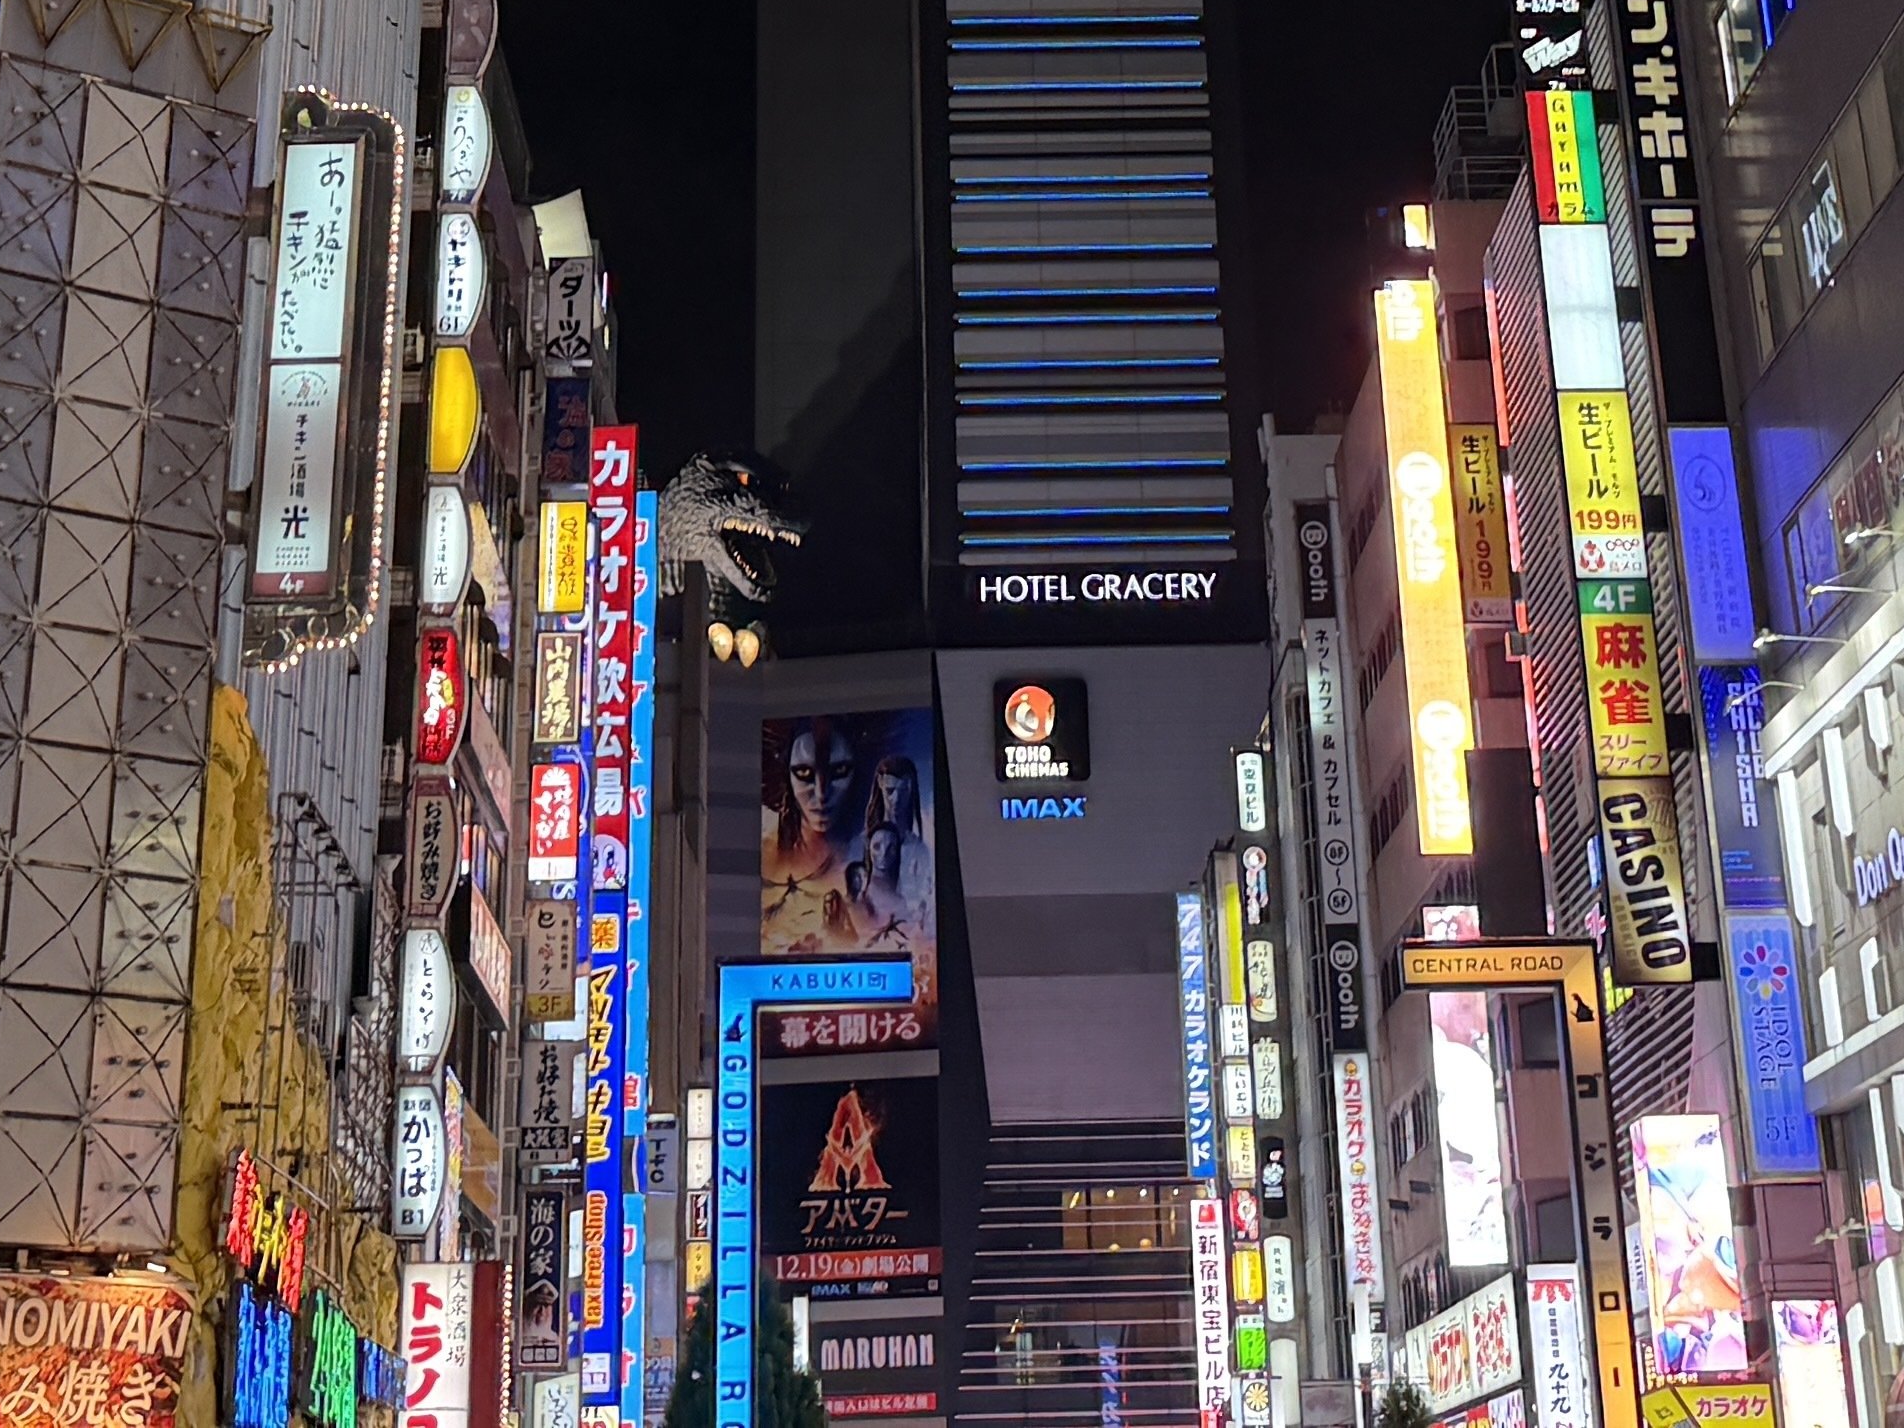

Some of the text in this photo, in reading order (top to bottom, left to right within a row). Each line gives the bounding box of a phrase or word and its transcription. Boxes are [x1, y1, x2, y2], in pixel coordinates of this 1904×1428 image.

[1578, 402, 1608, 499] 生ビール
[1462, 434, 1486, 514] 生ビール
[281, 505, 309, 540] 光
[1575, 509, 1637, 530] 199円
[980, 572, 1217, 603] HOTEL GRACERY
[1593, 587, 1636, 611] 4F
[1595, 622, 1653, 728] 麻雀
[1005, 746, 1051, 762] TOHO
[1599, 735, 1647, 750] スリー
[1005, 762, 1069, 778] CINEMAS
[1598, 753, 1663, 771] ファイブ
[1000, 797, 1087, 820] IMAX
[1601, 791, 1687, 969] CASINO
[1853, 847, 1888, 907] Don
[1413, 956, 1564, 974] CENTRAL ROAD
[538, 997, 561, 1013] 3F
[780, 1012, 922, 1048] 幕を開ける
[1752, 1005, 1775, 1090] STAGE
[1775, 1005, 1792, 1075] IDOL
[408, 1057, 431, 1071] 1F
[586, 965, 617, 1163] マツモトキヨシ
[404, 1099, 430, 1112] 新宿
[1345, 1077, 1365, 1161] カラオケ
[401, 1116, 430, 1198] かっぱ
[402, 1210, 424, 1225] B1
[587, 1191, 608, 1241] Shop
[720, 1055, 746, 1343] GODZILLA
[530, 1198, 554, 1274] 海の家
[585, 1244, 606, 1291] Free
[445, 1269, 467, 1367] 大衆酒場
[1198, 1234, 1227, 1408] 新宿東宝ビル店
[821, 1334, 934, 1371] MARUHAN
[1697, 1396, 1769, 1417] カラオケ
